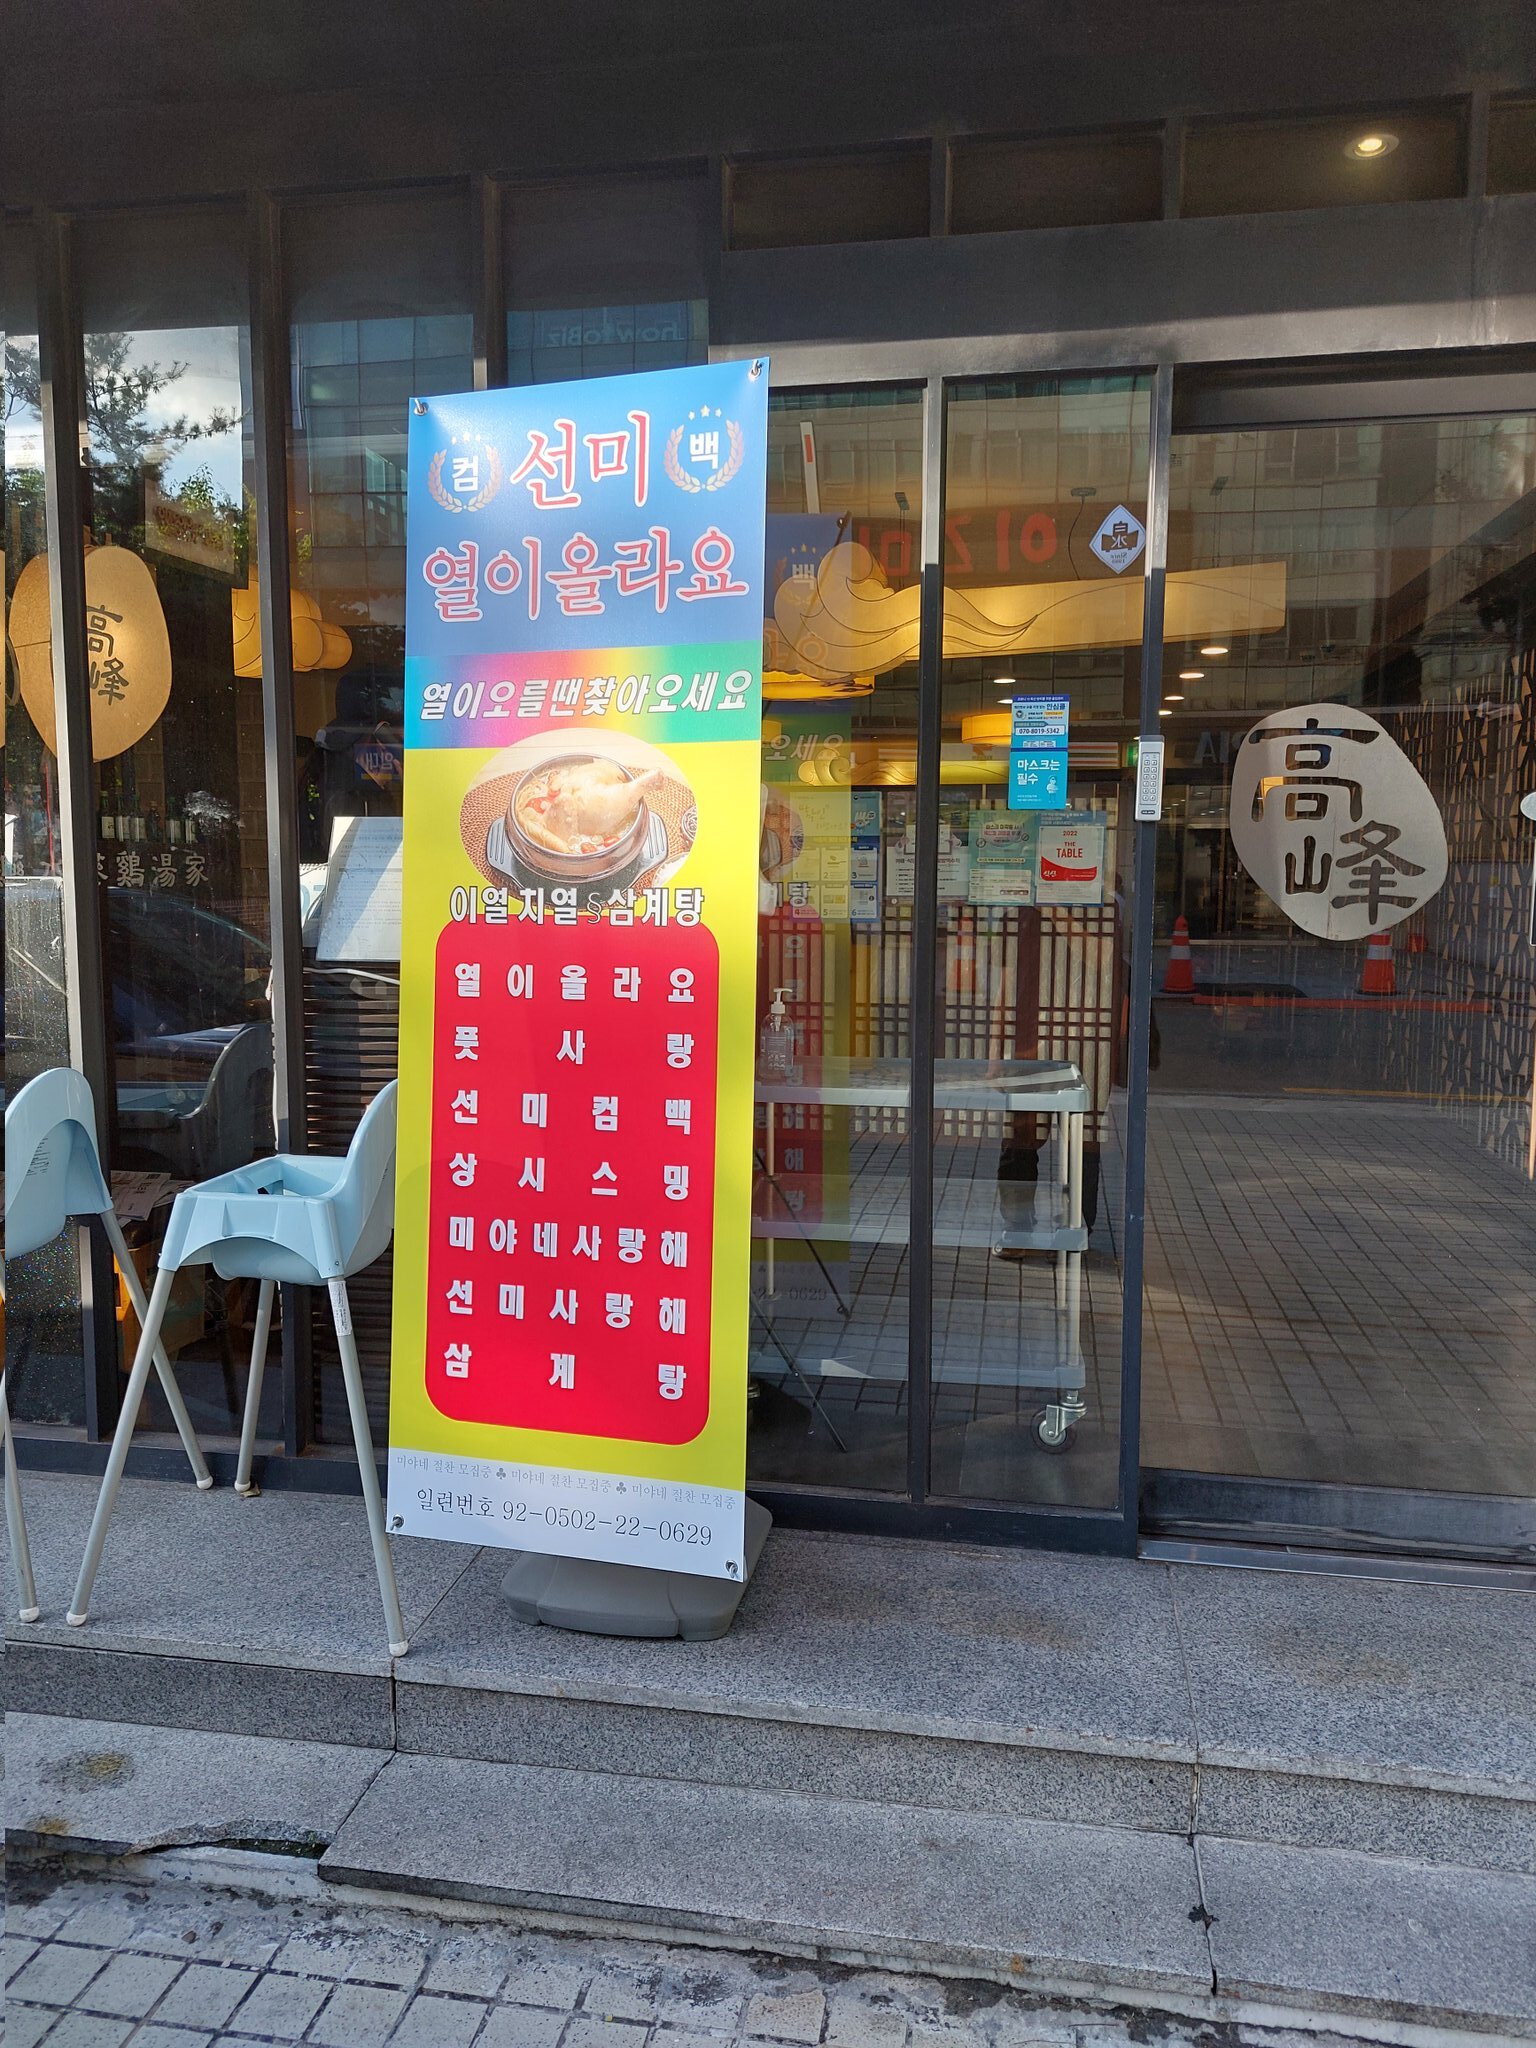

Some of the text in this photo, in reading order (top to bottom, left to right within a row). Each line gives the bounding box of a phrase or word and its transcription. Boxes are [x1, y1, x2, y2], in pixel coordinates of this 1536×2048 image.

[452, 410, 719, 510] 컴 선미 백
[423, 525, 749, 622] 열이올라요
[420, 669, 753, 721] 열이오를땐찾아오세요
[1017, 759, 1061, 771] 마스크는
[1017, 773, 1039, 785] 필수
[1056, 848, 1083, 858] TABLE
[607, 887, 705, 927] 삼계탕
[396, 1454, 430, 1471] 미야네
[458, 1463, 492, 1479] 모집중
[511, 1469, 545, 1485] 미야네
[577, 1477, 612, 1494] 모집중
[631, 1483, 667, 1501] 미야네
[700, 1492, 736, 1511] 모집중
[416, 1487, 713, 1548] 일련번호 92-0502-22-0629
